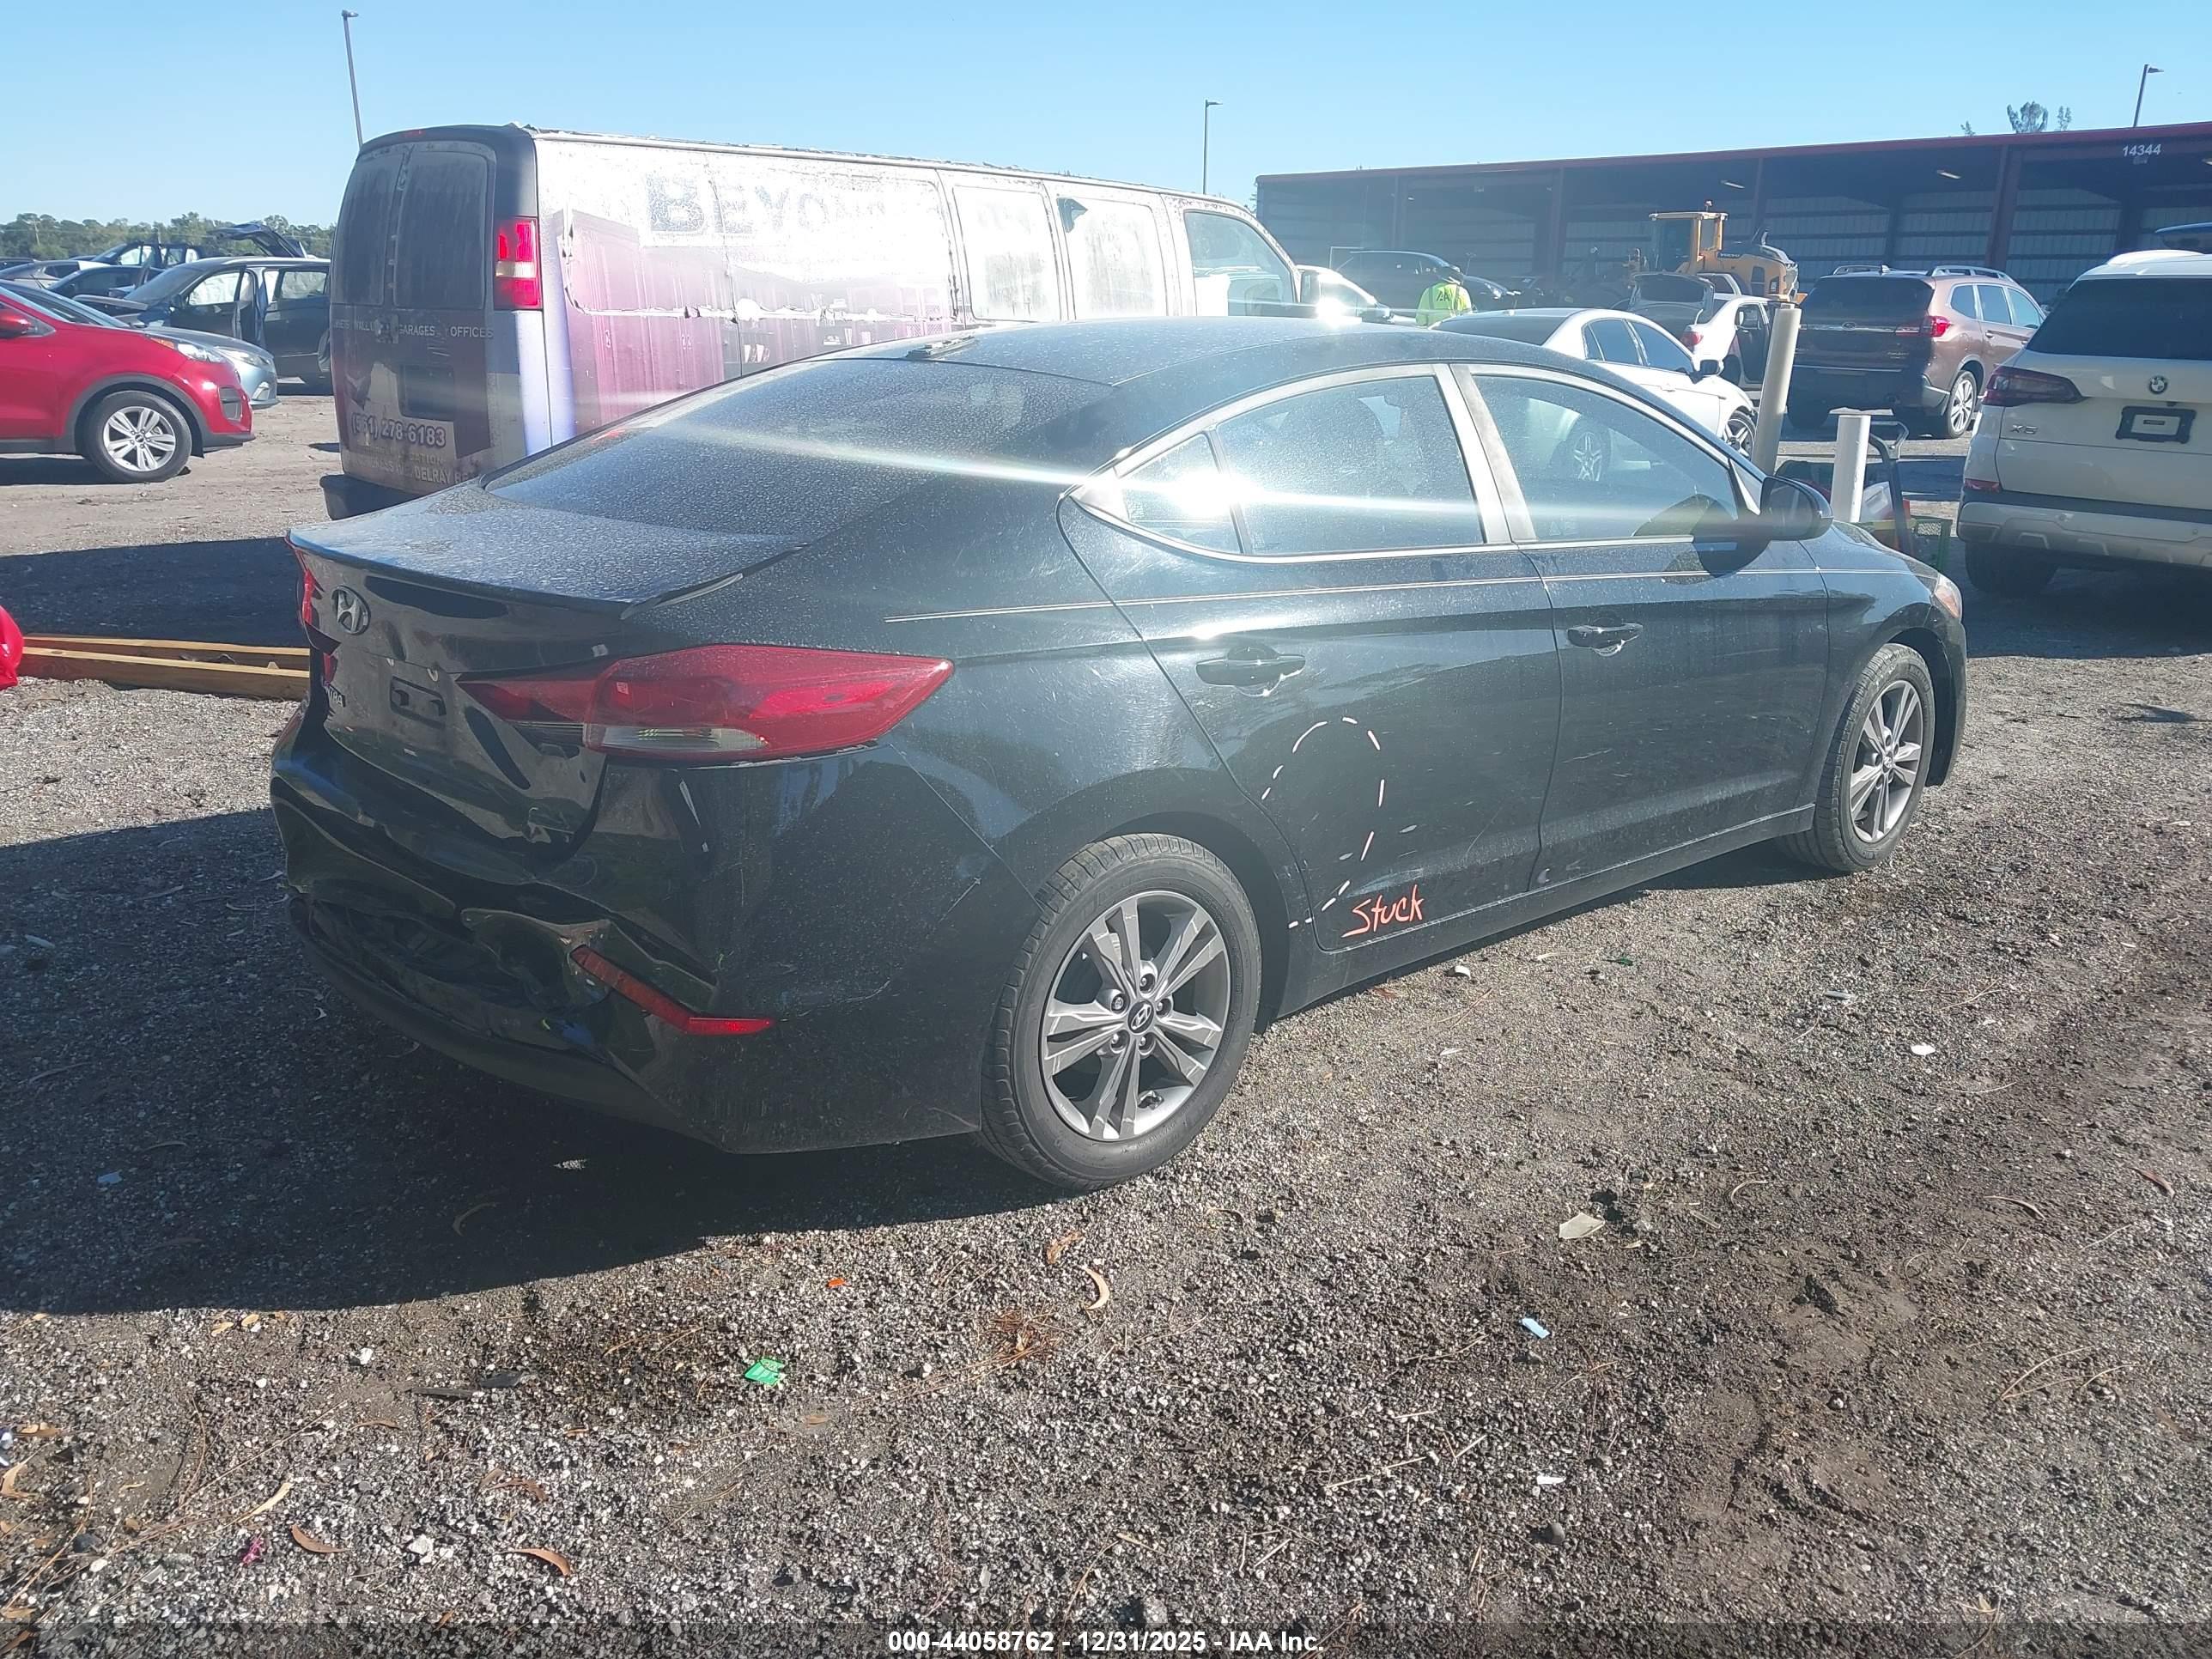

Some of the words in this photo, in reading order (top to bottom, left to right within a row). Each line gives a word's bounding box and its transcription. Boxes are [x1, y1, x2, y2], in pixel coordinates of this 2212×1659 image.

[2122, 143, 2161, 157] 14344
[449, 325, 495, 338] OFFICES
[414, 465, 452, 485] DELRAY
